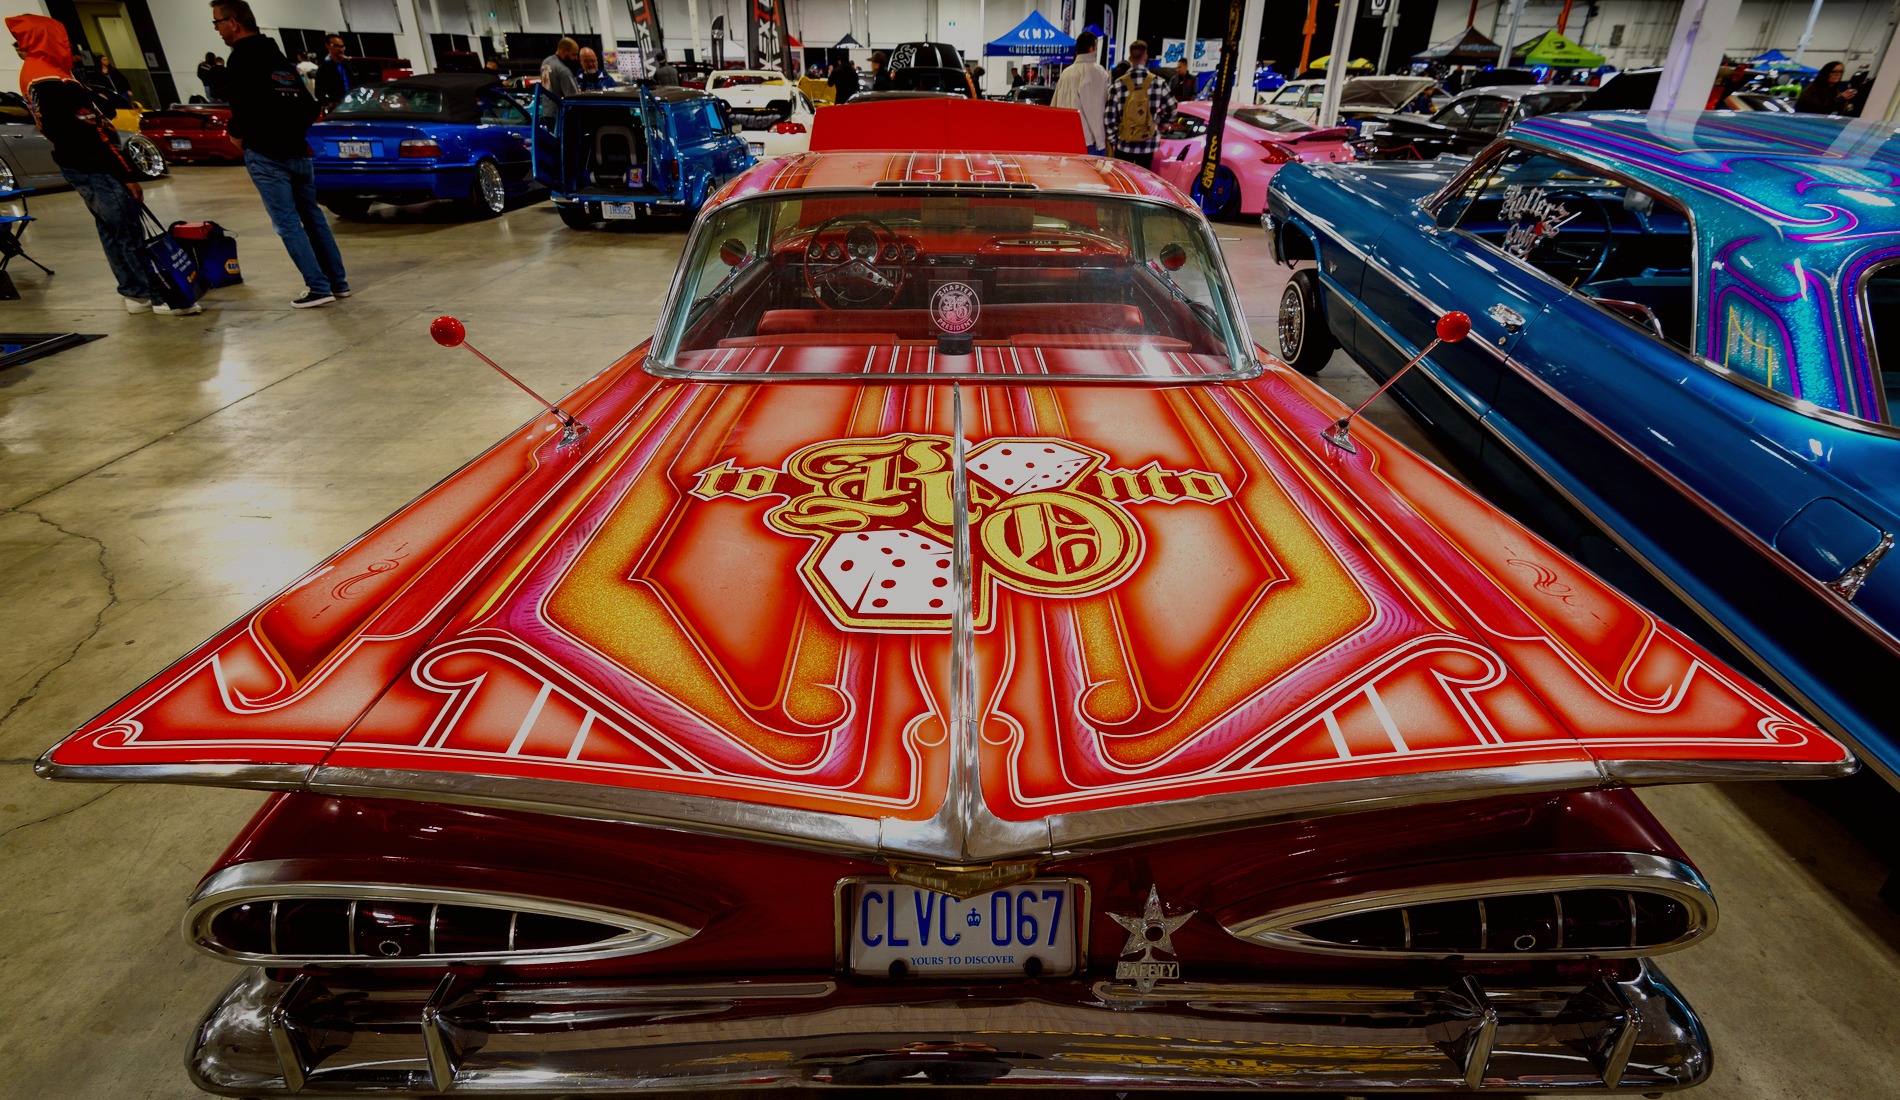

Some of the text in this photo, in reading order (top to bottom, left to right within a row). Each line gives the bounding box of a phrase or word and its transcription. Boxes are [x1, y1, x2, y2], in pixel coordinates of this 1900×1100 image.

[1015, 45, 1062, 55] WIRELESSWAVE
[936, 284, 974, 298] CHAPTER
[936, 317, 974, 332] PRESIDENT
[862, 891, 1064, 947] CLVC 067
[910, 955, 1015, 966] YOURS TO DISCOVER
[1118, 963, 1177, 977] SAFETY
